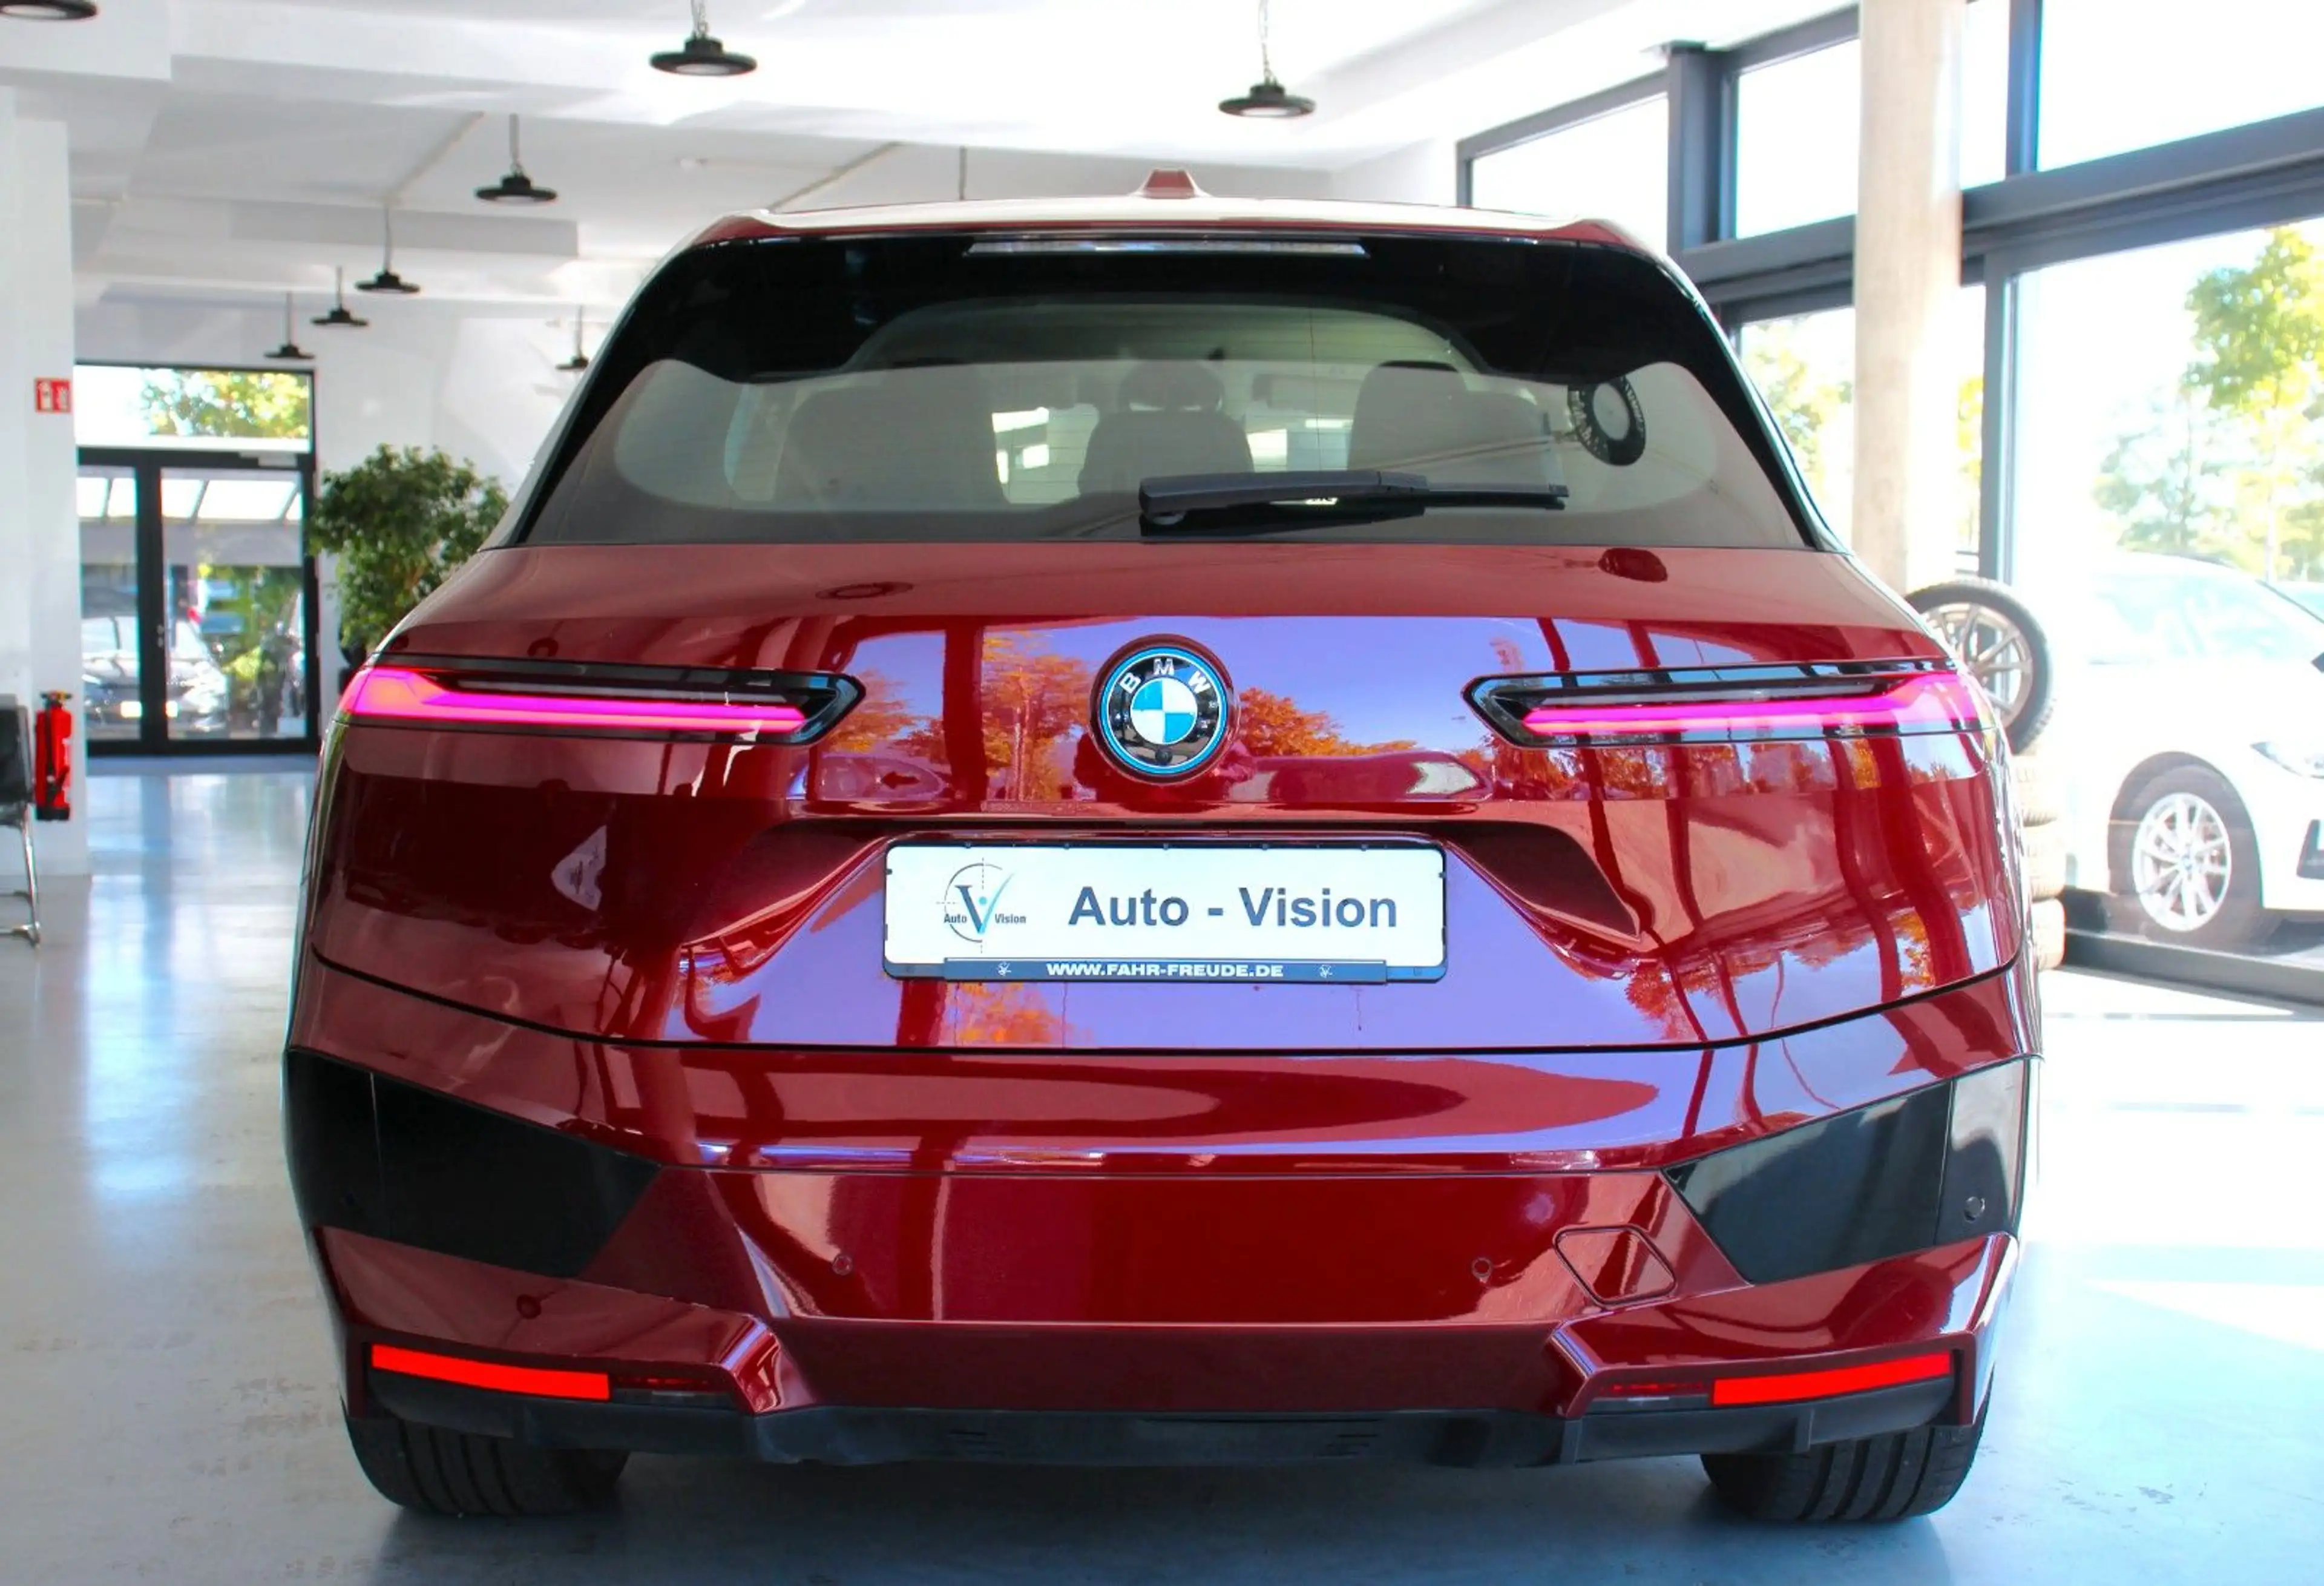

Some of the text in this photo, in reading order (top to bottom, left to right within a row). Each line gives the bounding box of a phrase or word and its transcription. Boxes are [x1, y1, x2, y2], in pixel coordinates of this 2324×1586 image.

[1120, 658, 1210, 694] BMW
[944, 913, 1027, 924] Auto Vision
[1068, 886, 1189, 926] Auto
[1238, 887, 1397, 927] Vision
[1046, 963, 1284, 977] WWW.FAHR-FREUDE.DE
